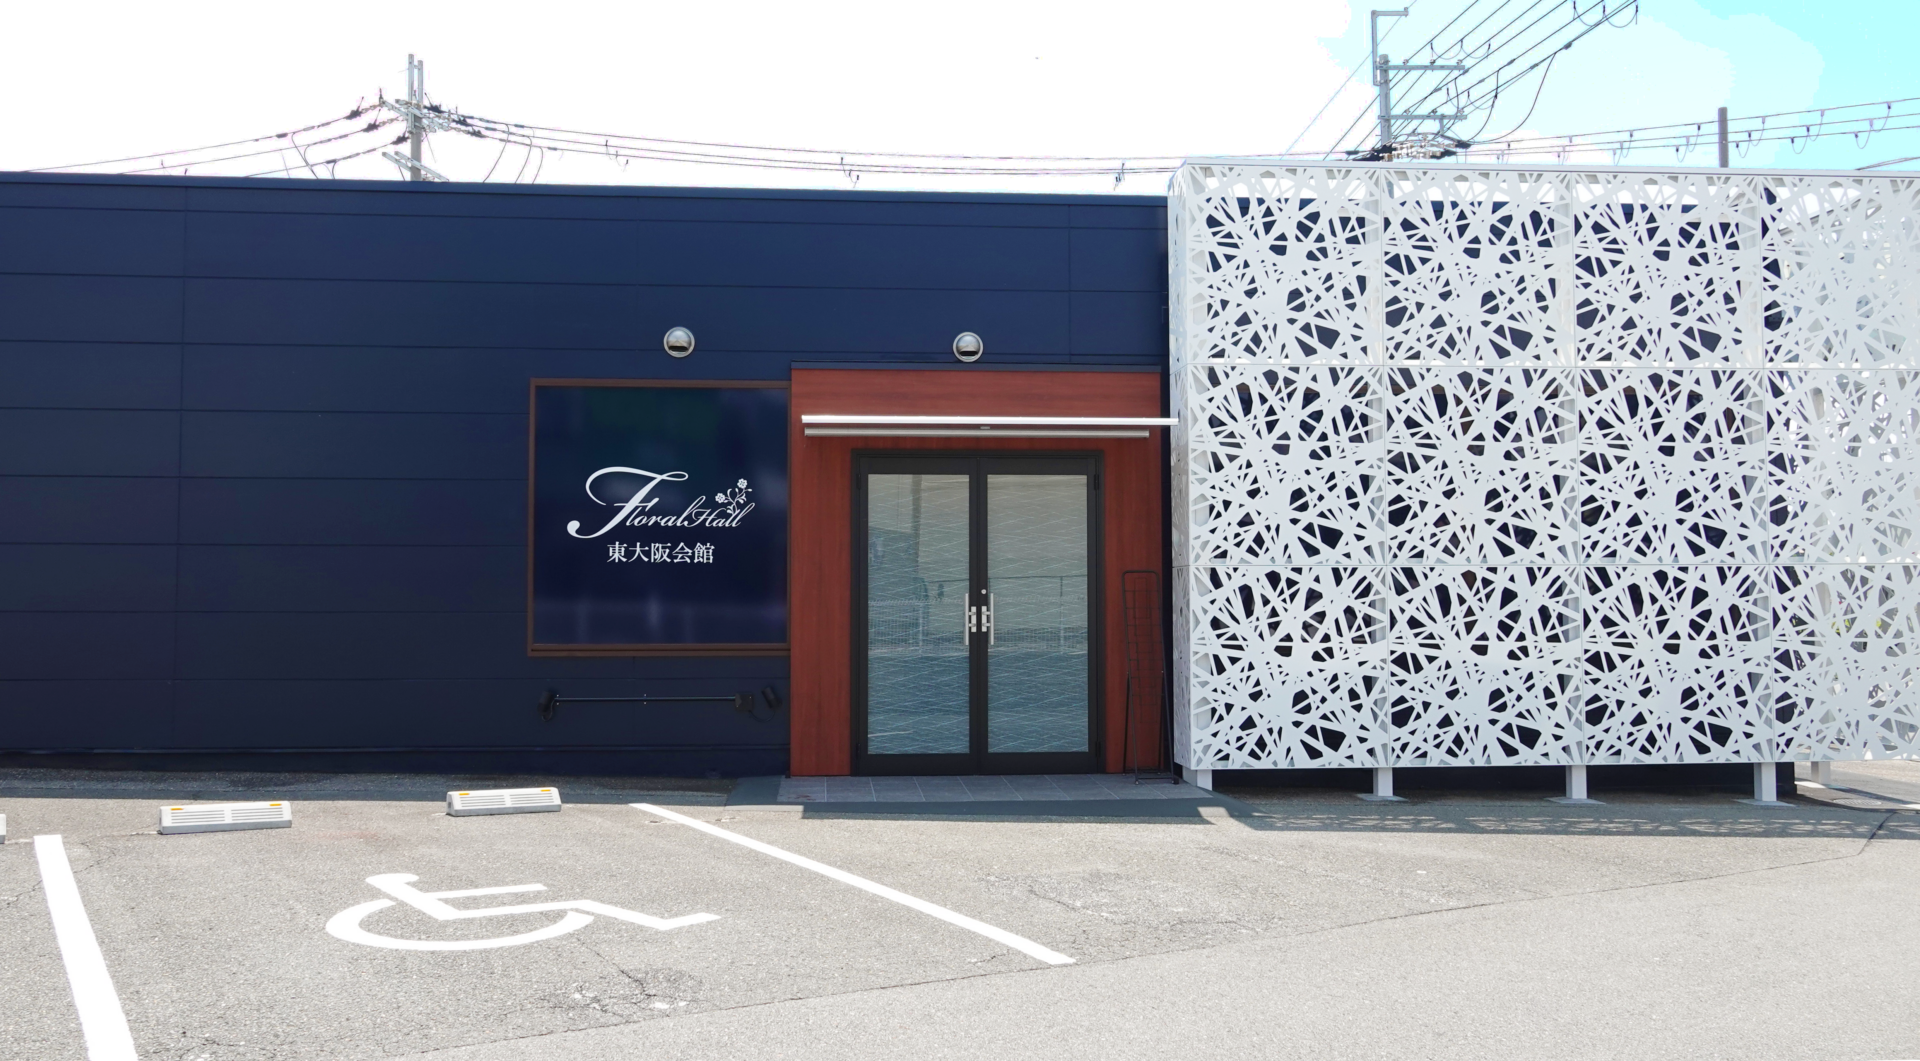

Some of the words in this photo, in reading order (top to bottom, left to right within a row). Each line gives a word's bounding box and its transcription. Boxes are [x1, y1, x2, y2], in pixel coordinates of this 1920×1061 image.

[567, 466, 706, 539] Floral
[691, 502, 756, 527] Hall
[606, 541, 716, 564] 東大阪会館
